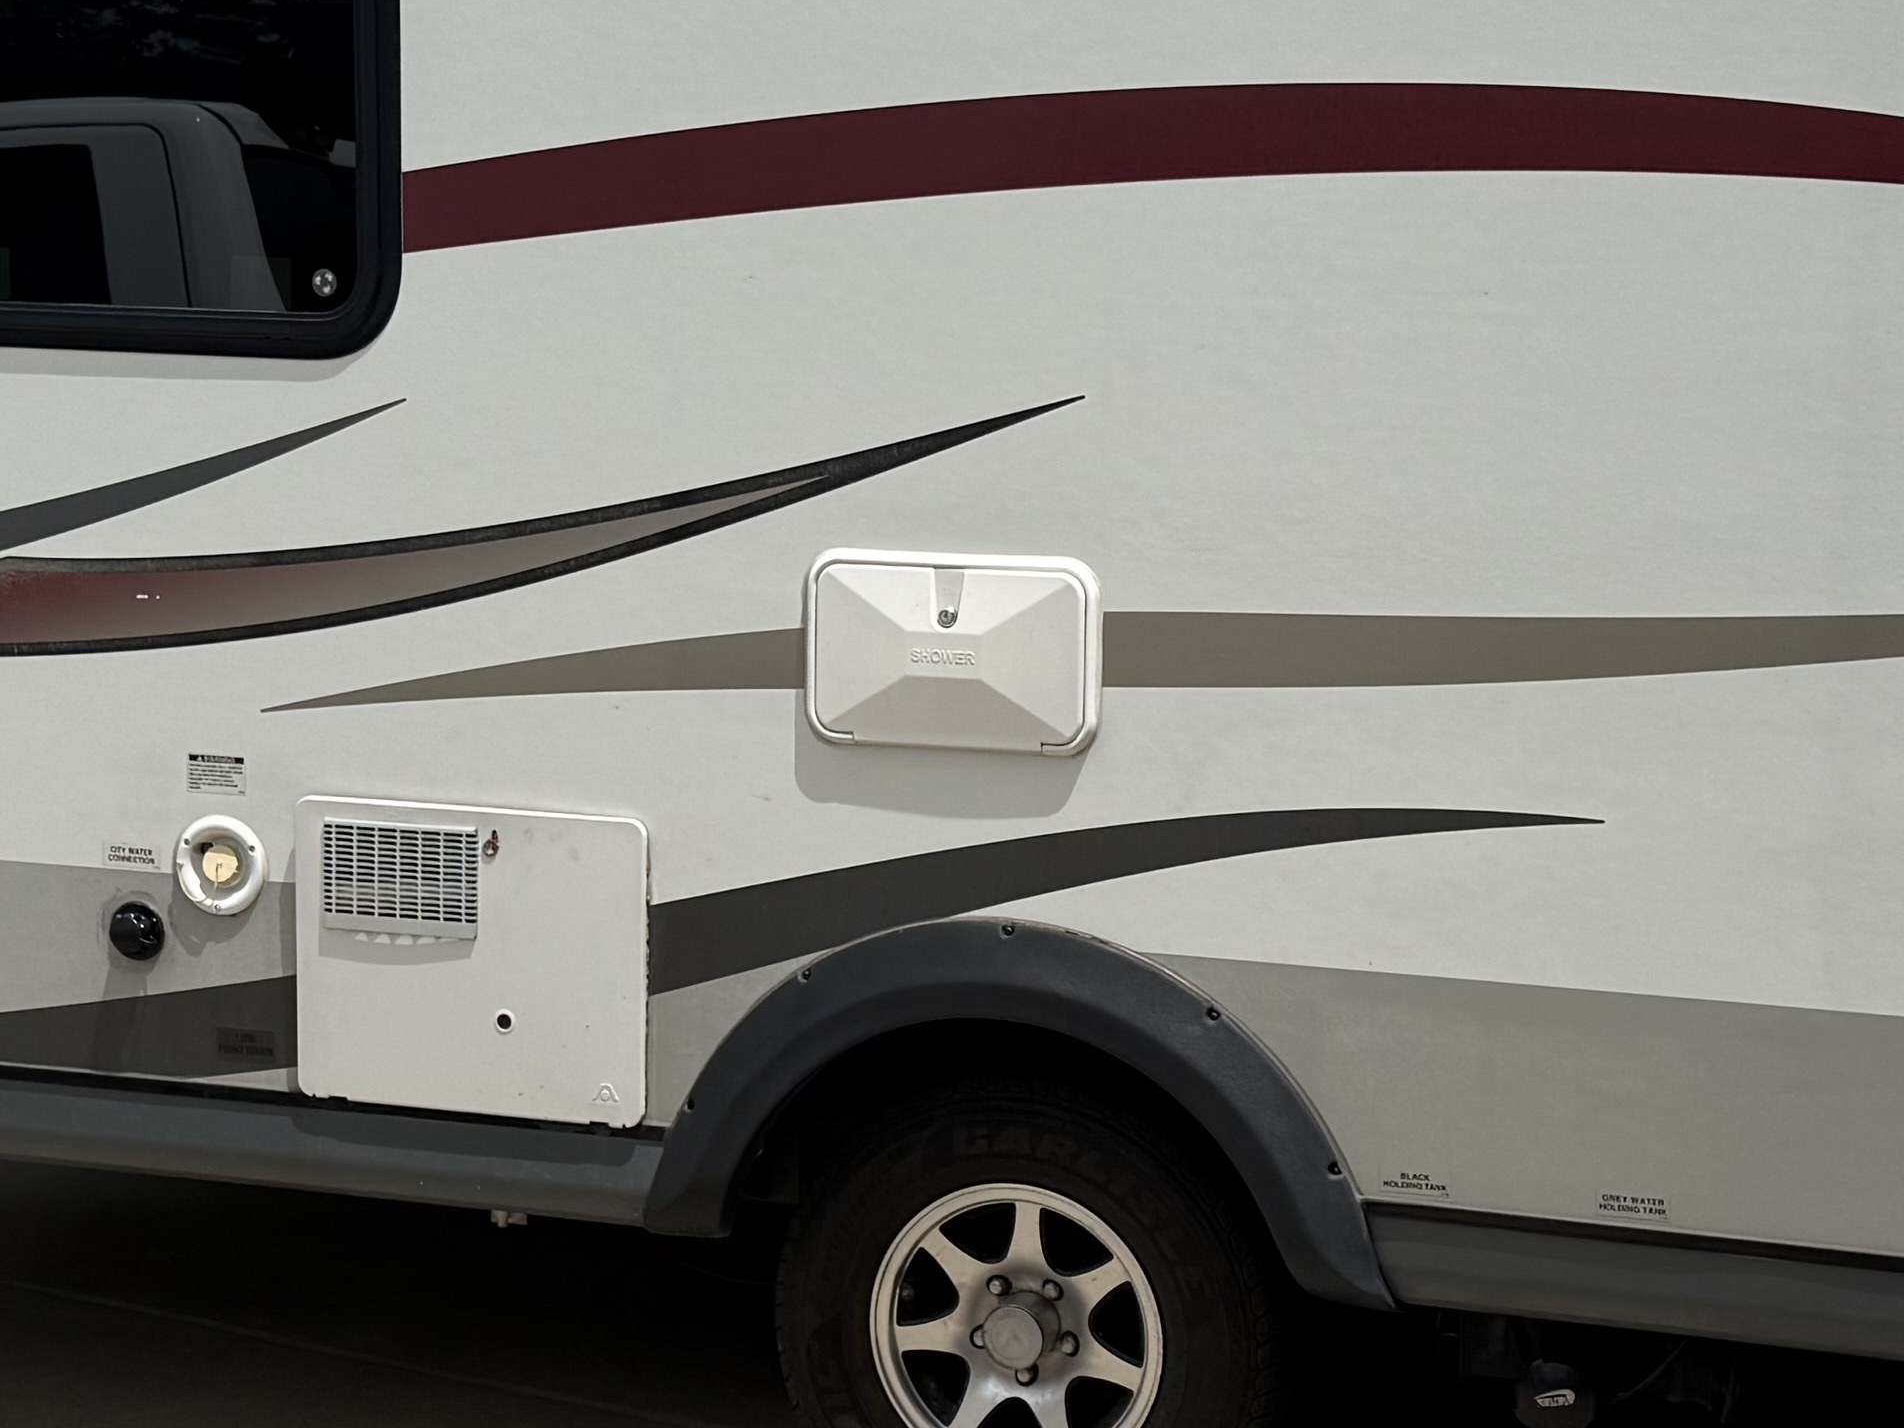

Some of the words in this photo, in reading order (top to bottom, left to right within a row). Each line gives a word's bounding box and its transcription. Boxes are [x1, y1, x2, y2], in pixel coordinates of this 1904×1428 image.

[911, 647, 976, 666] SHOWER
[1400, 1172, 1430, 1181] BLACK
[1383, 1180, 1423, 1190] HOLDING
[1425, 1183, 1446, 1191] TANK
[1630, 1196, 1664, 1206] WATER
[1599, 1203, 1640, 1213] HOLDING
